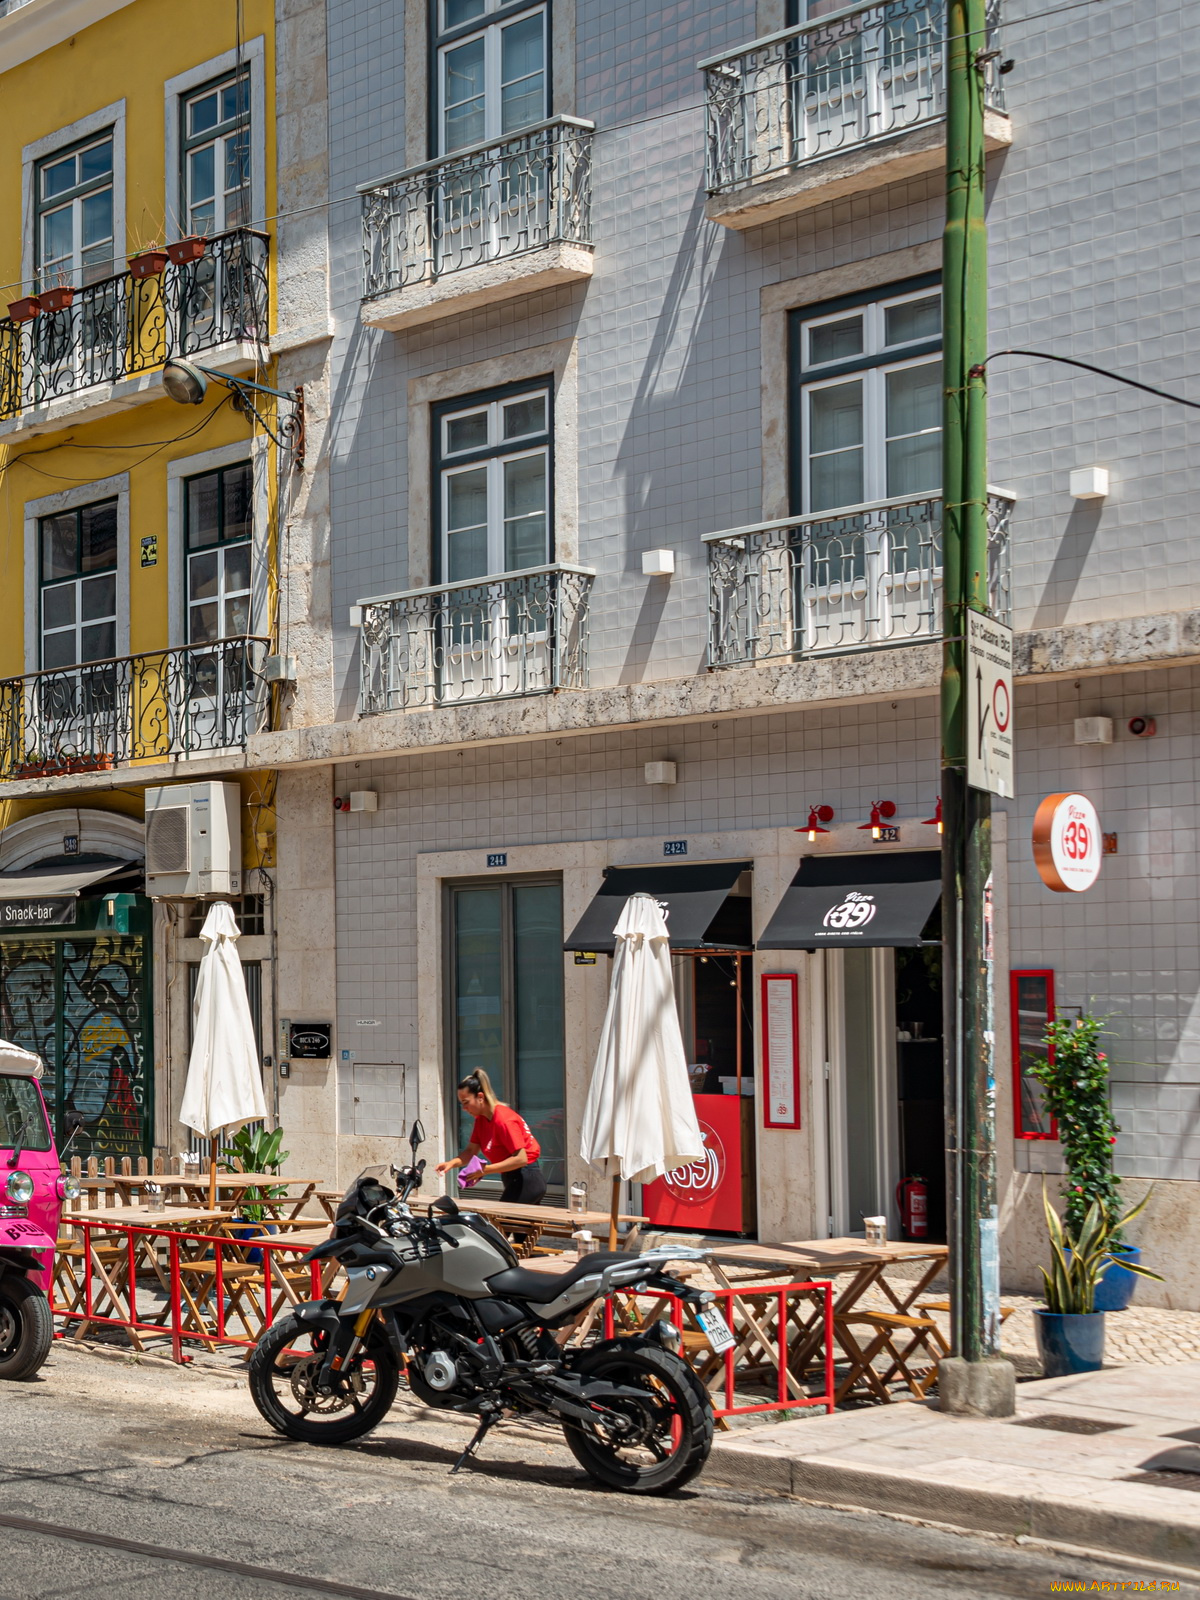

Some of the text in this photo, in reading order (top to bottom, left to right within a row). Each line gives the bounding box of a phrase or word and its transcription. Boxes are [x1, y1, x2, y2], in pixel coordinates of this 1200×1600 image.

[65, 838, 77, 851] 248
[665, 843, 686, 854] 242A
[490, 855, 504, 865] 244
[5, 904, 53, 921] Snack-bar
